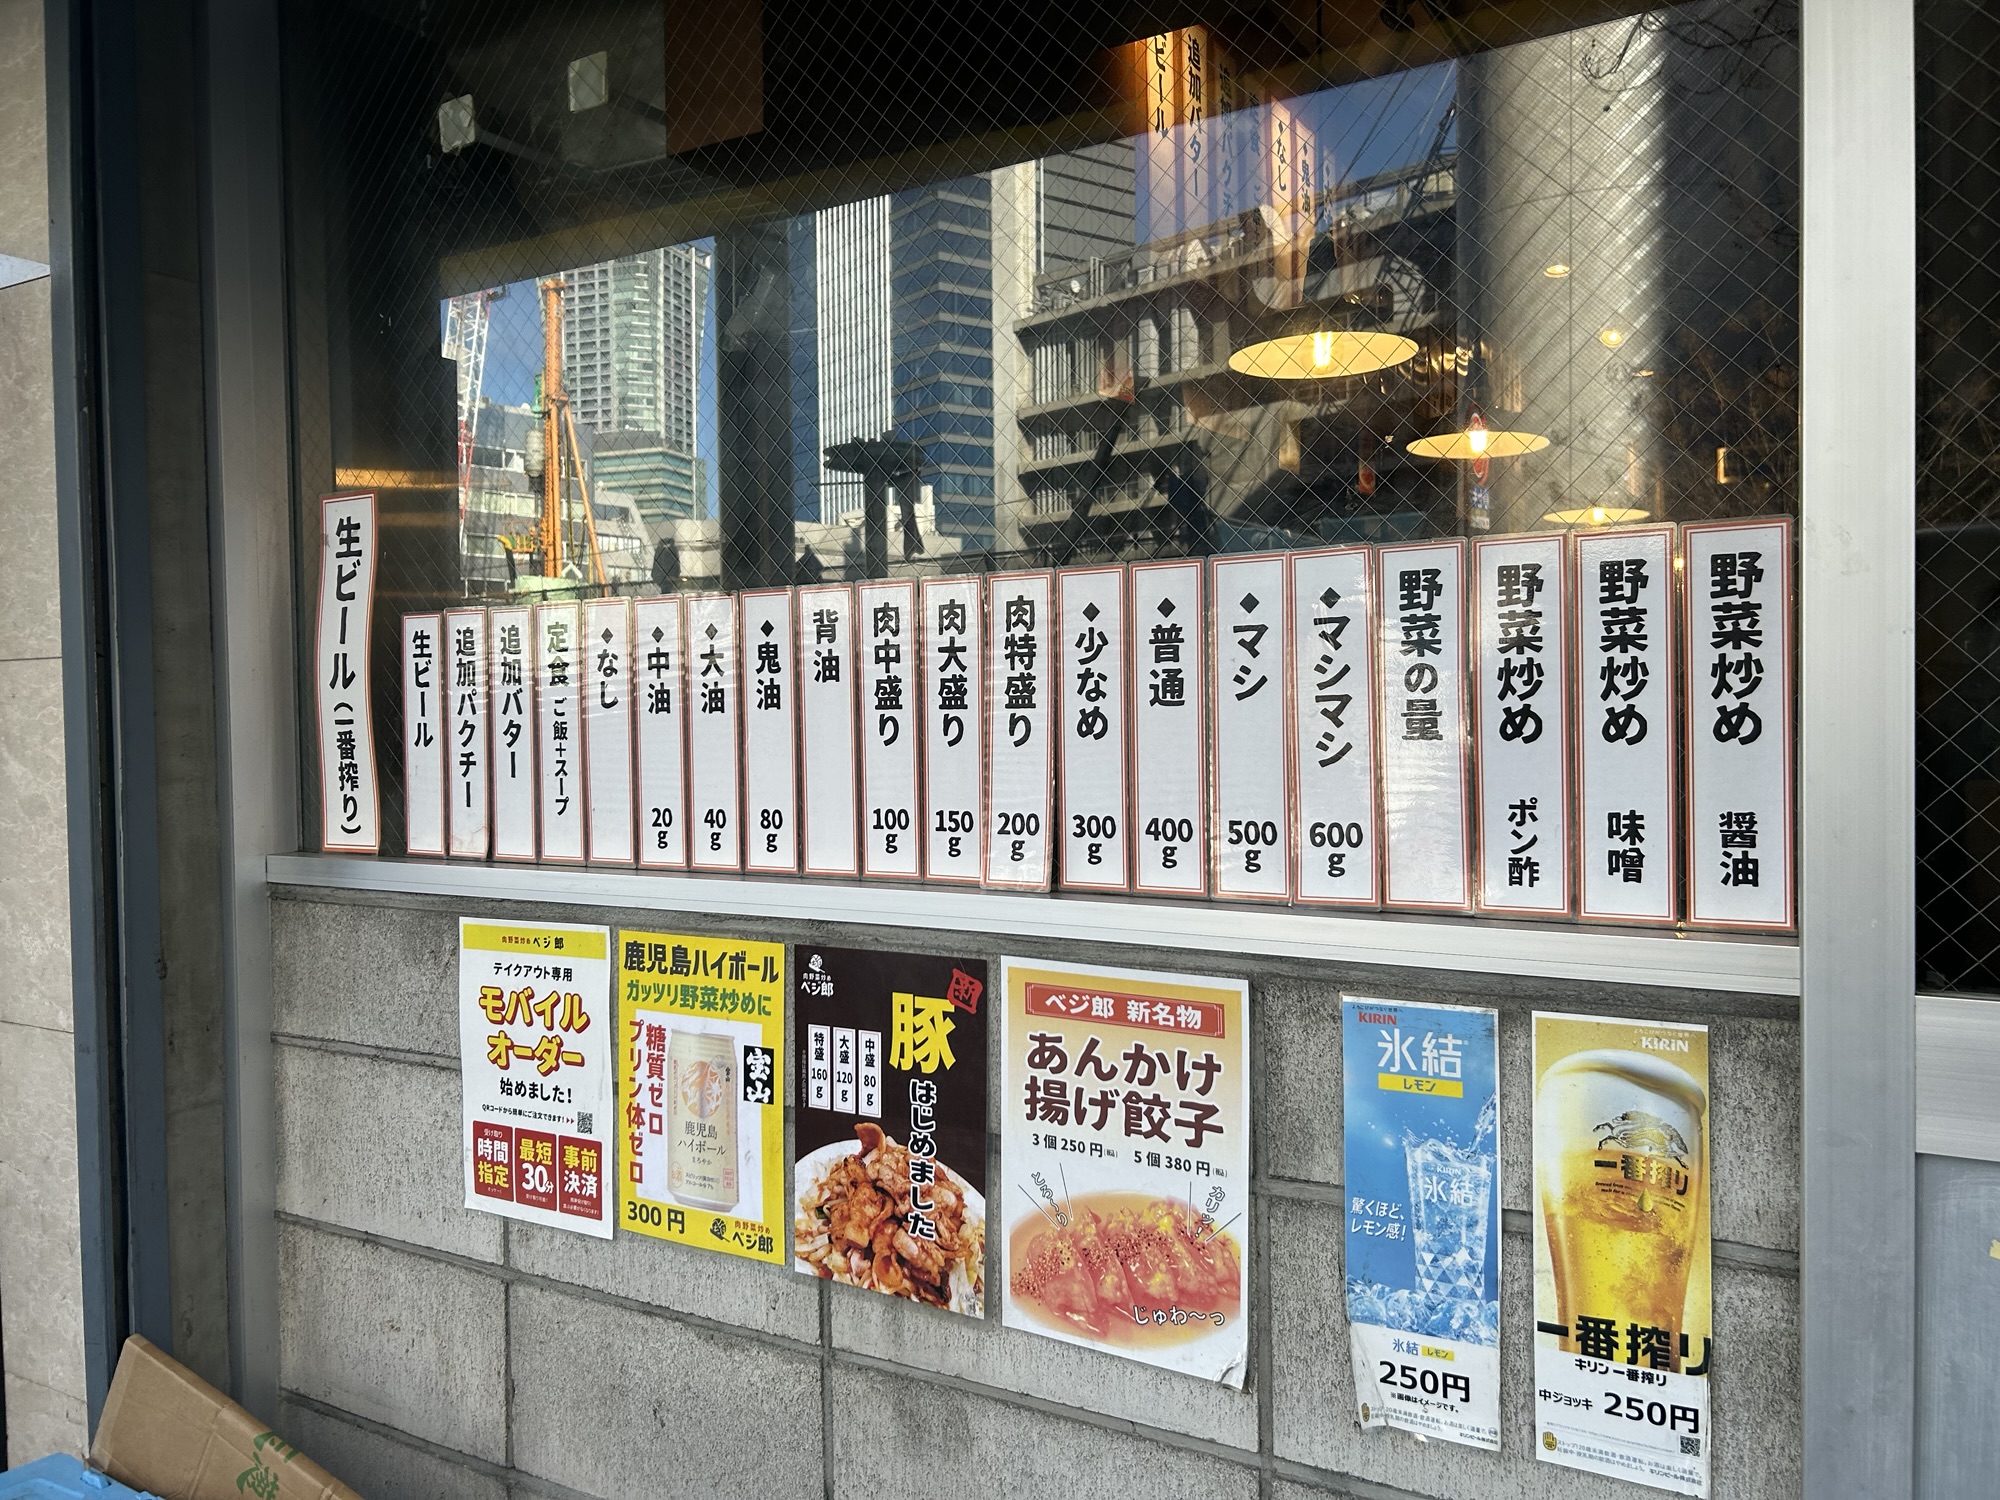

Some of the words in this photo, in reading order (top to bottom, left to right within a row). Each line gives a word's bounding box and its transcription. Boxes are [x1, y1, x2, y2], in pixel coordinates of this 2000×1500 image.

[1153, 32, 1168, 138] ビール
[1187, 33, 1201, 197] 追加バター
[547, 620, 570, 687] 定食
[813, 608, 840, 683] 背油
[1148, 623, 1185, 708] 普通
[1232, 623, 1270, 702] マシ
[1398, 568, 1443, 741] 野菜の量
[1496, 562, 1545, 745] 野菜炒め
[1598, 558, 1650, 746] 野菜炒め
[1709, 551, 1764, 746] 野菜炒め
[412, 629, 434, 748] 生ビール
[597, 650, 620, 709] なし
[646, 647, 672, 715] 中油
[700, 643, 726, 715] 大油
[756, 642, 782, 712] 鬼油
[873, 601, 903, 747] 肉中盛り
[938, 599, 968, 747] 肉大盛り
[1004, 595, 1037, 748] 肉特盛り
[1075, 626, 1109, 741] 少なめ
[1313, 615, 1353, 769] マシマシ
[455, 626, 477, 808] 追加パクチー
[500, 624, 522, 779] 追加バター
[1507, 796, 1541, 889] ポン酢
[1607, 809, 1646, 884] 味噌
[1718, 810, 1760, 888] 醤油
[533, 936, 564, 950] ベジ郎
[623, 940, 779, 984] 鹿児島ハイボール
[493, 962, 573, 982] テイクアウト専用
[800, 980, 834, 997] ベジ郎
[478, 985, 591, 1034] モバイル
[626, 979, 772, 1016] ガッツリ野菜炒めに
[1045, 993, 1115, 1020] ベジ郎
[1126, 999, 1202, 1030] 新名物
[1358, 1011, 1398, 1025] KIRIN
[487, 1030, 585, 1077] オーダー
[814, 1032, 825, 1062] 特盛
[839, 1035, 850, 1065] 大盛
[865, 1037, 875, 1068] 中盛
[889, 991, 957, 1074] 豚
[1377, 1028, 1463, 1079] 氷結
[1641, 1036, 1689, 1053] KIRIN
[645, 1023, 667, 1136] 糖質ゼロ
[1027, 1032, 1223, 1097] あんかけ
[1403, 1077, 1437, 1093] レモン
[500, 1077, 572, 1104] 始めました！
[625, 1019, 646, 1184] プリン体ゼロ
[1023, 1075, 1225, 1149] 揚げ餃子
[477, 1137, 509, 1164] 時間
[483, 1128, 503, 1139] 受け取り
[519, 1138, 553, 1166] 最短
[677, 1138, 727, 1156] ハイボール
[684, 1120, 718, 1140] 鹿児島
[478, 1160, 509, 1188] 指定
[521, 1162, 555, 1194] 30分
[563, 1145, 598, 1173] 事前
[909, 1078, 937, 1240] はじめました
[1593, 1154, 1689, 1196] 一番搾り
[563, 1169, 598, 1199] 決済
[1424, 1175, 1474, 1208] 氷結
[734, 1219, 771, 1234] 肉野菜炒め
[1350, 1196, 1406, 1222] 驚くほど、
[1350, 1217, 1406, 1242] レモン感！
[732, 1232, 774, 1254] ベジ郎
[1392, 1338, 1420, 1356] 氷結
[1427, 1347, 1449, 1359] レモン
[1537, 1314, 1711, 1376] 一番搾り
[1379, 1360, 1470, 1403] 250円
[1538, 1388, 1594, 1411] 中ジョッキ
[1603, 1391, 1700, 1434] 250円
